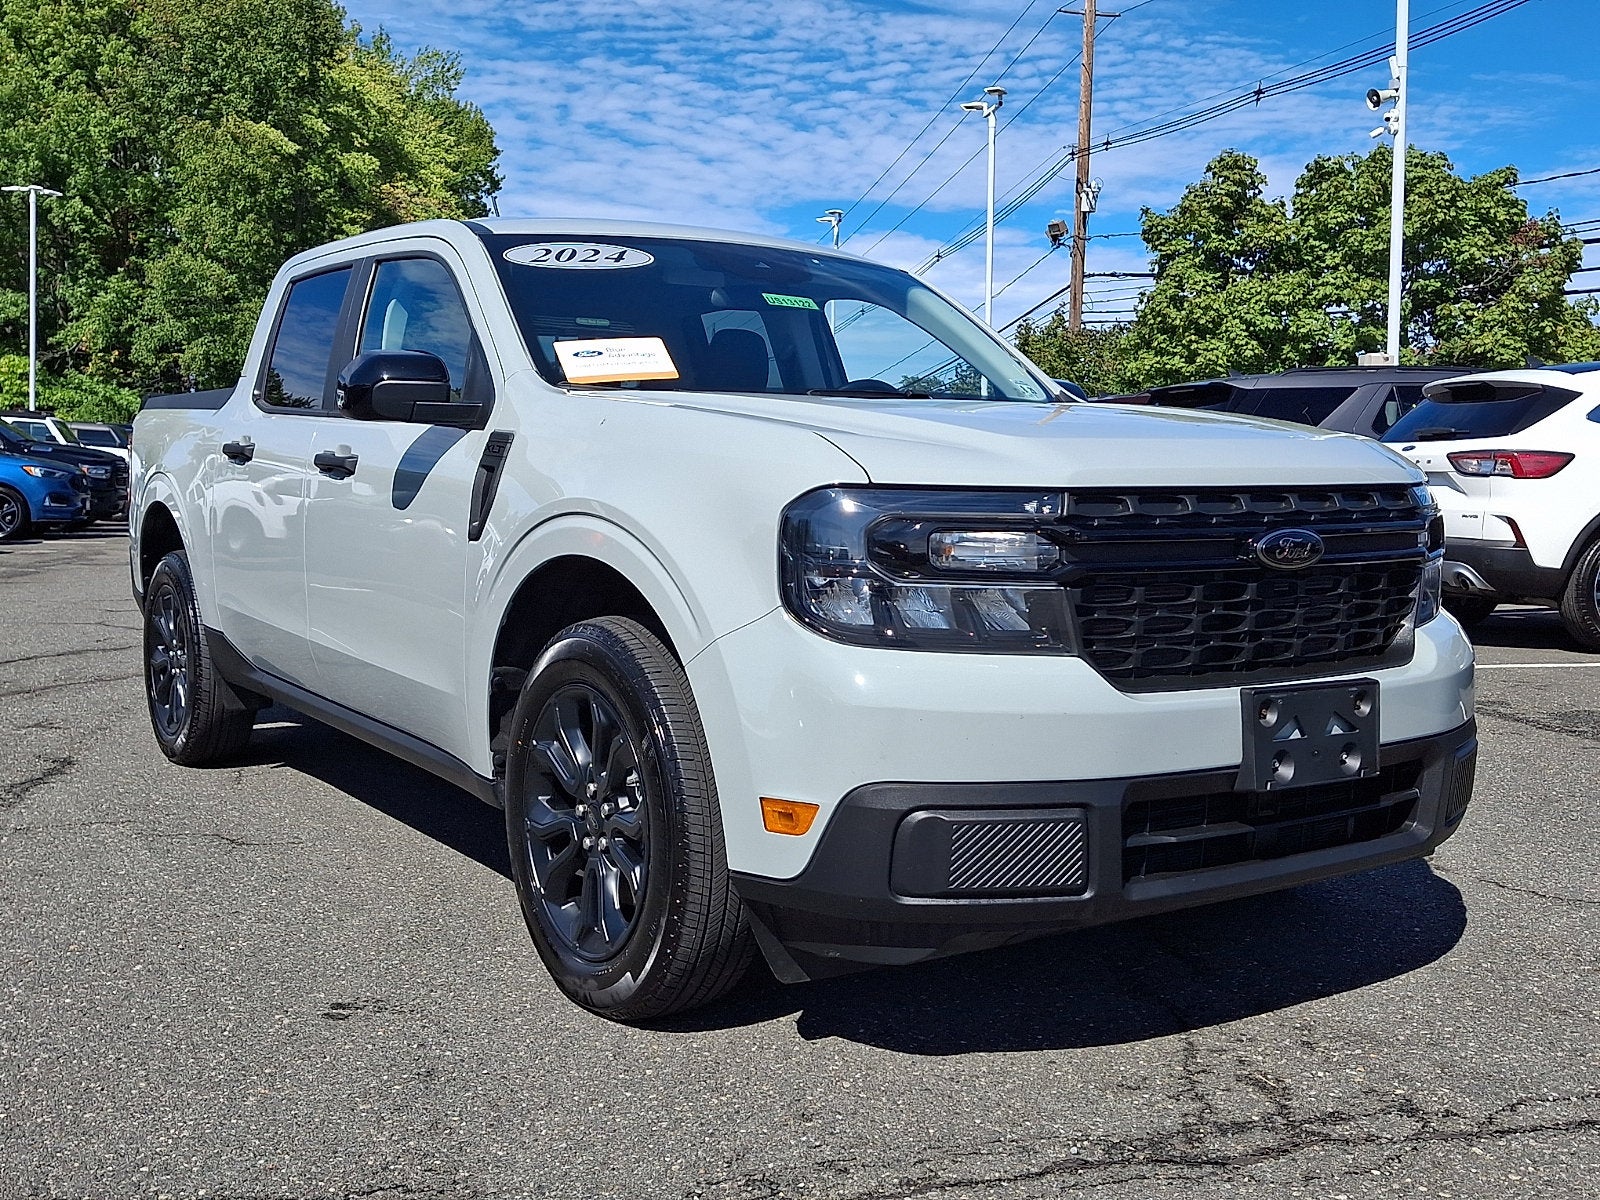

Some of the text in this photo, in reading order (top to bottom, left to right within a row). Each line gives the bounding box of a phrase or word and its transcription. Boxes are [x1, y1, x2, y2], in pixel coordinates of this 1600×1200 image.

[529, 247, 627, 265] 2024
[766, 295, 813, 309] US13122
[1275, 537, 1312, 560] Ford
